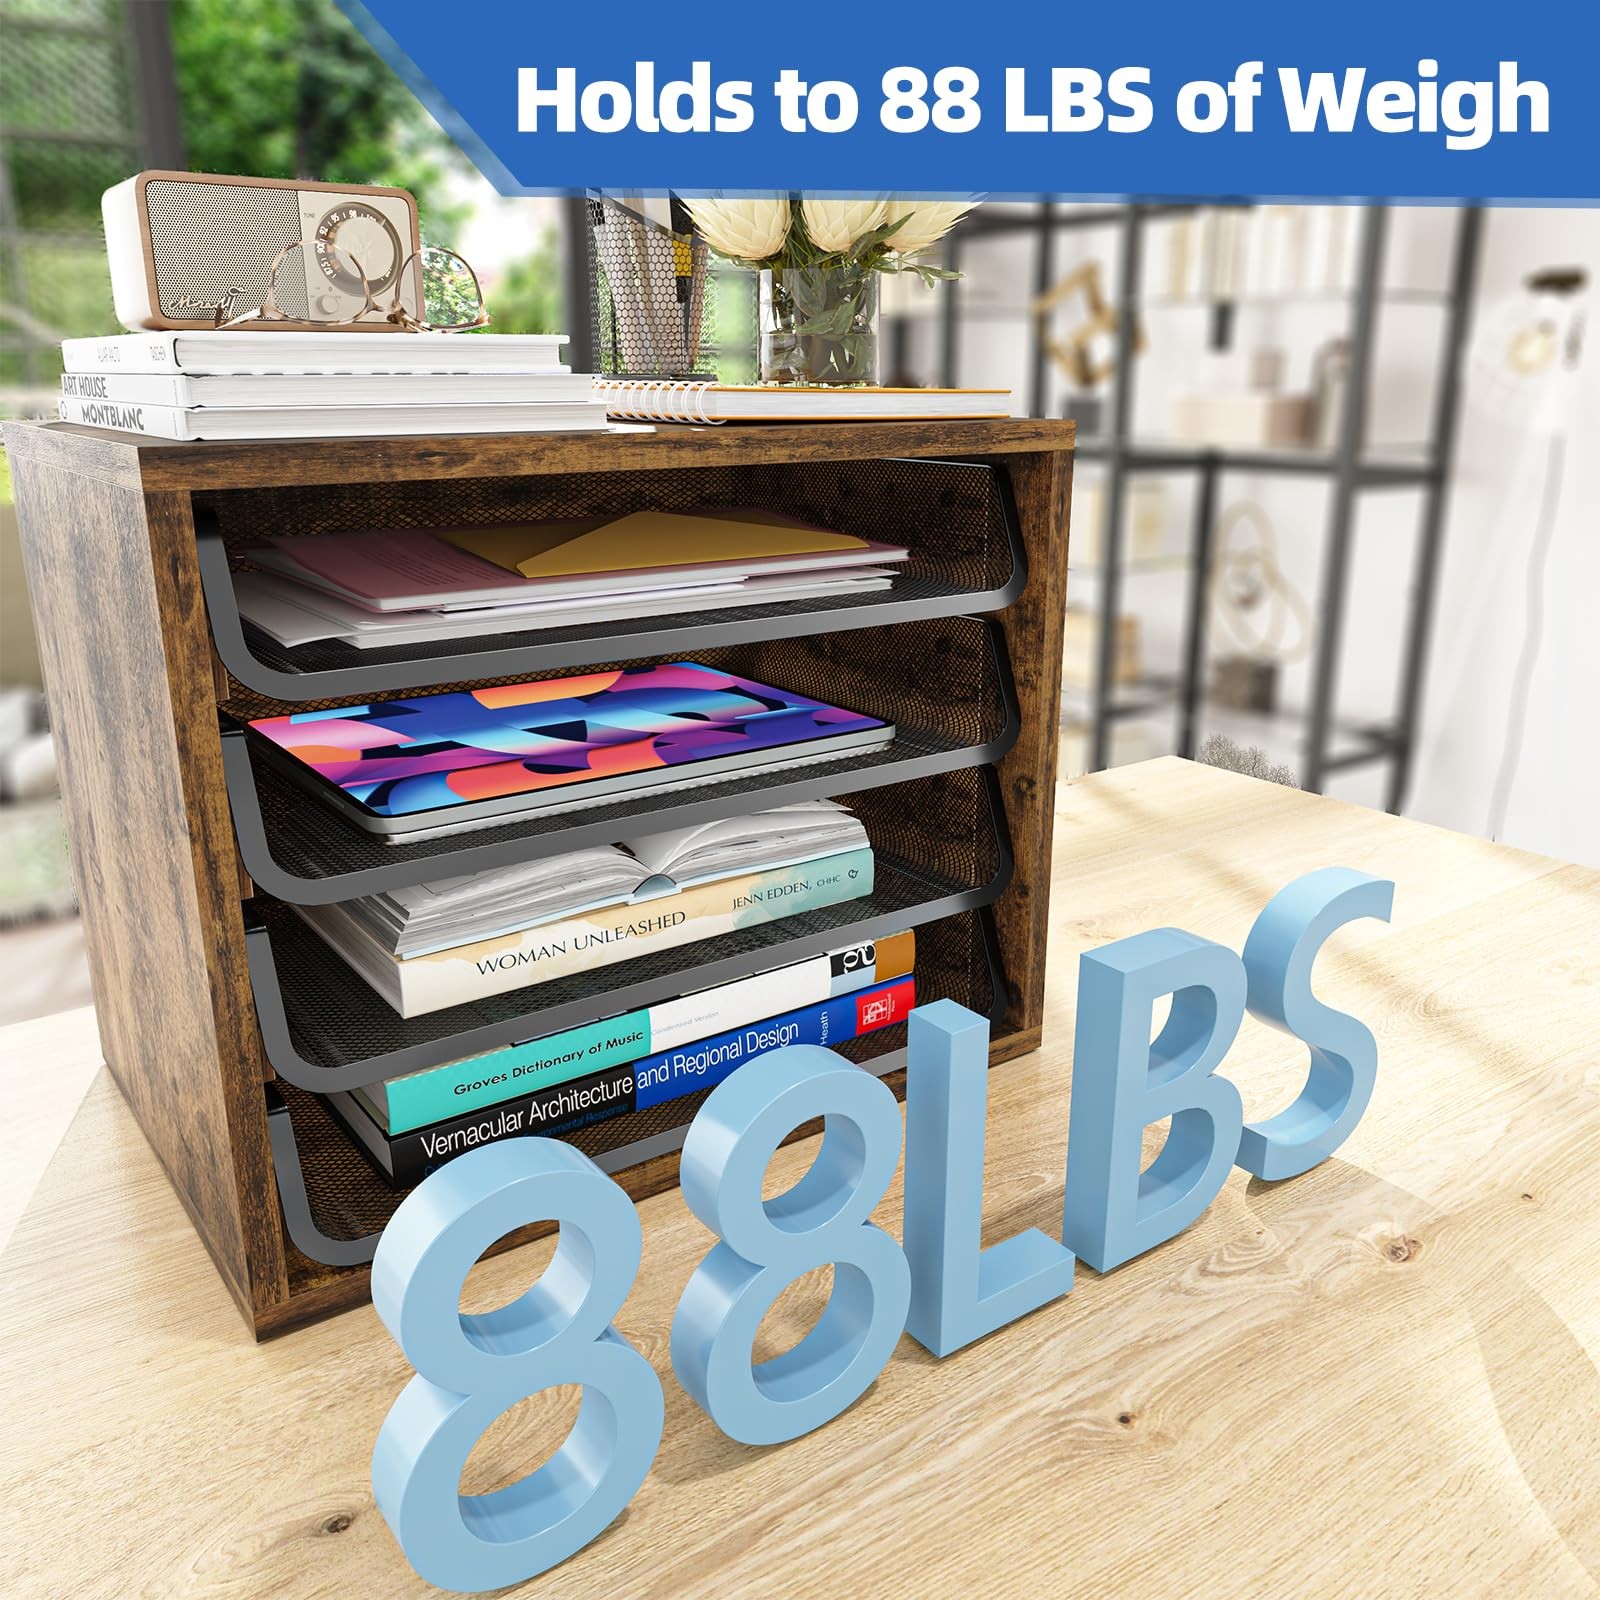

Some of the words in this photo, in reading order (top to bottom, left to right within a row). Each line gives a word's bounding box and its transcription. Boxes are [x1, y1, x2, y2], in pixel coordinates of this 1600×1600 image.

[331, 213, 340, 222] 95
[349, 210, 357, 218] 98
[63, 375, 78, 396] ART
[78, 376, 109, 399] HOUSE
[81, 404, 144, 430] MONTBLANC
[732, 892, 763, 911] JENN
[767, 880, 812, 900] EDDEN,
[476, 941, 567, 976] WOMAN
[574, 911, 686, 951] UNLEASHED
[453, 1073, 508, 1096] Groves
[512, 1049, 584, 1079] Dictionary
[588, 1040, 603, 1055] of
[605, 1031, 645, 1050] Music
[420, 1109, 524, 1158] Vernacular
[529, 1075, 634, 1126] Architecture
[637, 1060, 670, 1089] and
[673, 1036, 743, 1078] Regional
[746, 1021, 800, 1056] Design
